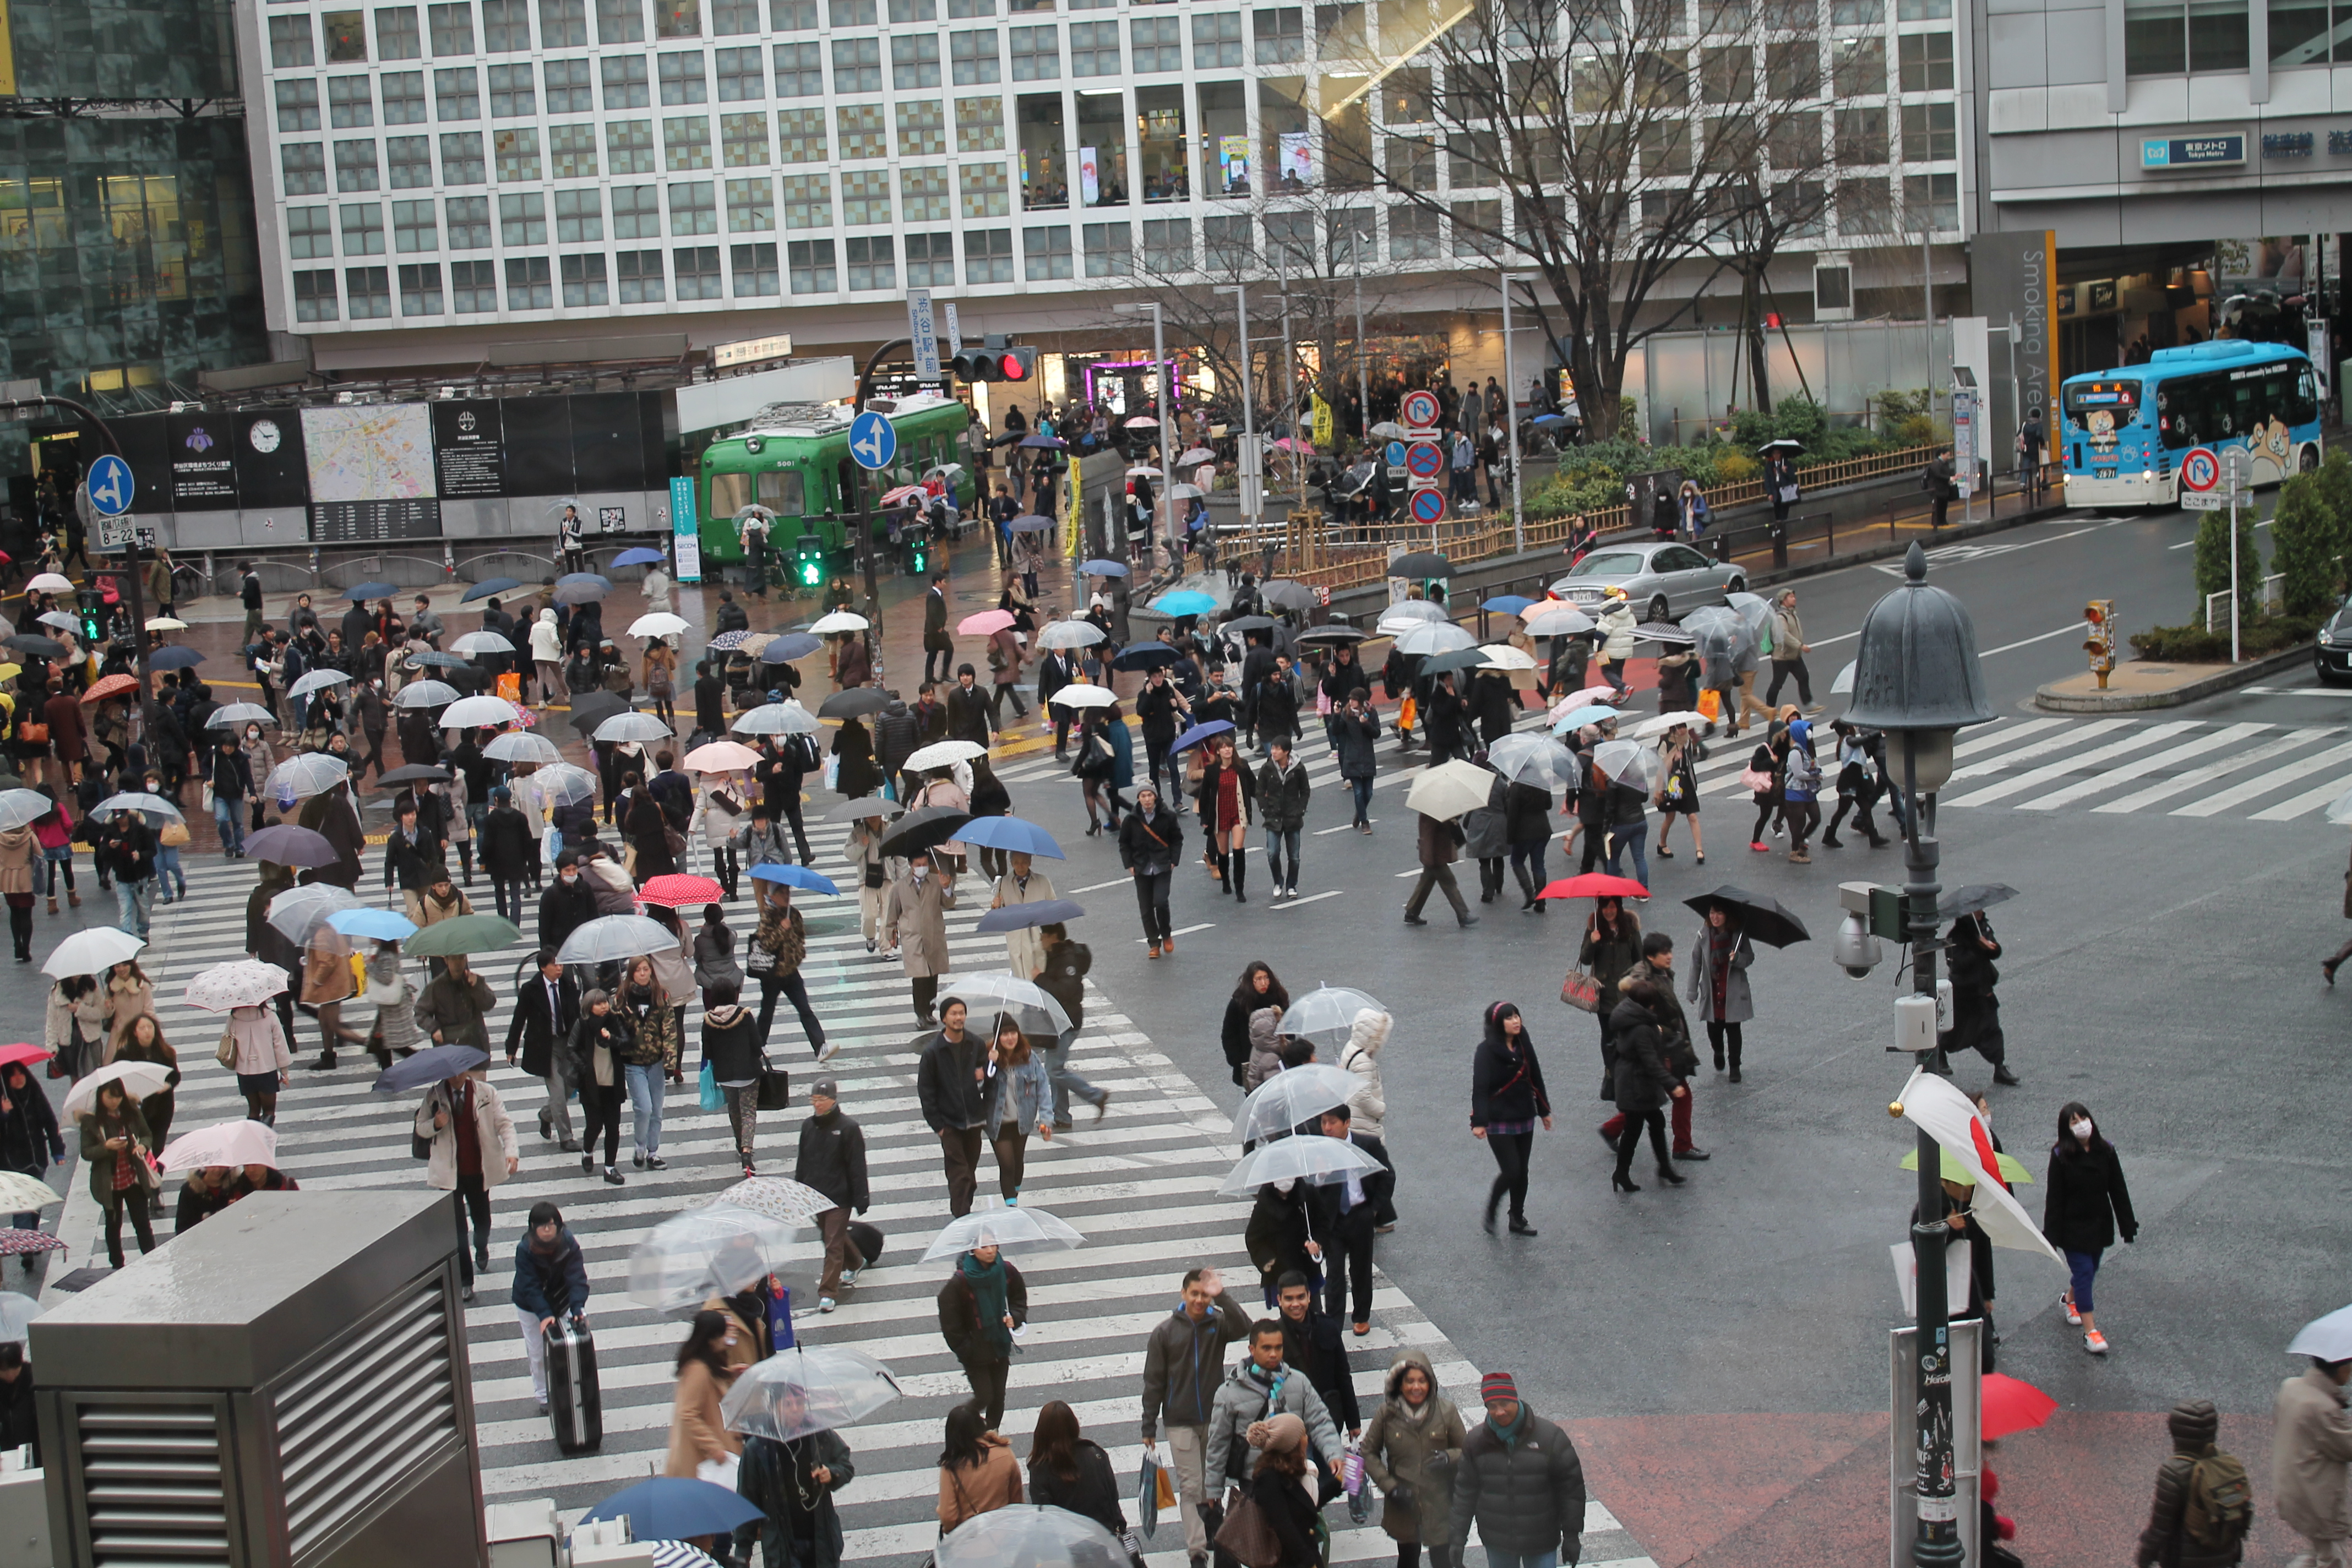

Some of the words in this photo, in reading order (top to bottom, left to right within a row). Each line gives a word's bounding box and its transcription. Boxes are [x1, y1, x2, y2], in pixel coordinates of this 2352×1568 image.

[2185, 141, 2227, 152] 東京メトロ
[2021, 250, 2045, 355] Smoking
[912, 309, 920, 344] Shibuya
[918, 297, 937, 373] 渋谷駅前
[2184, 497, 2218, 507] ここまで
